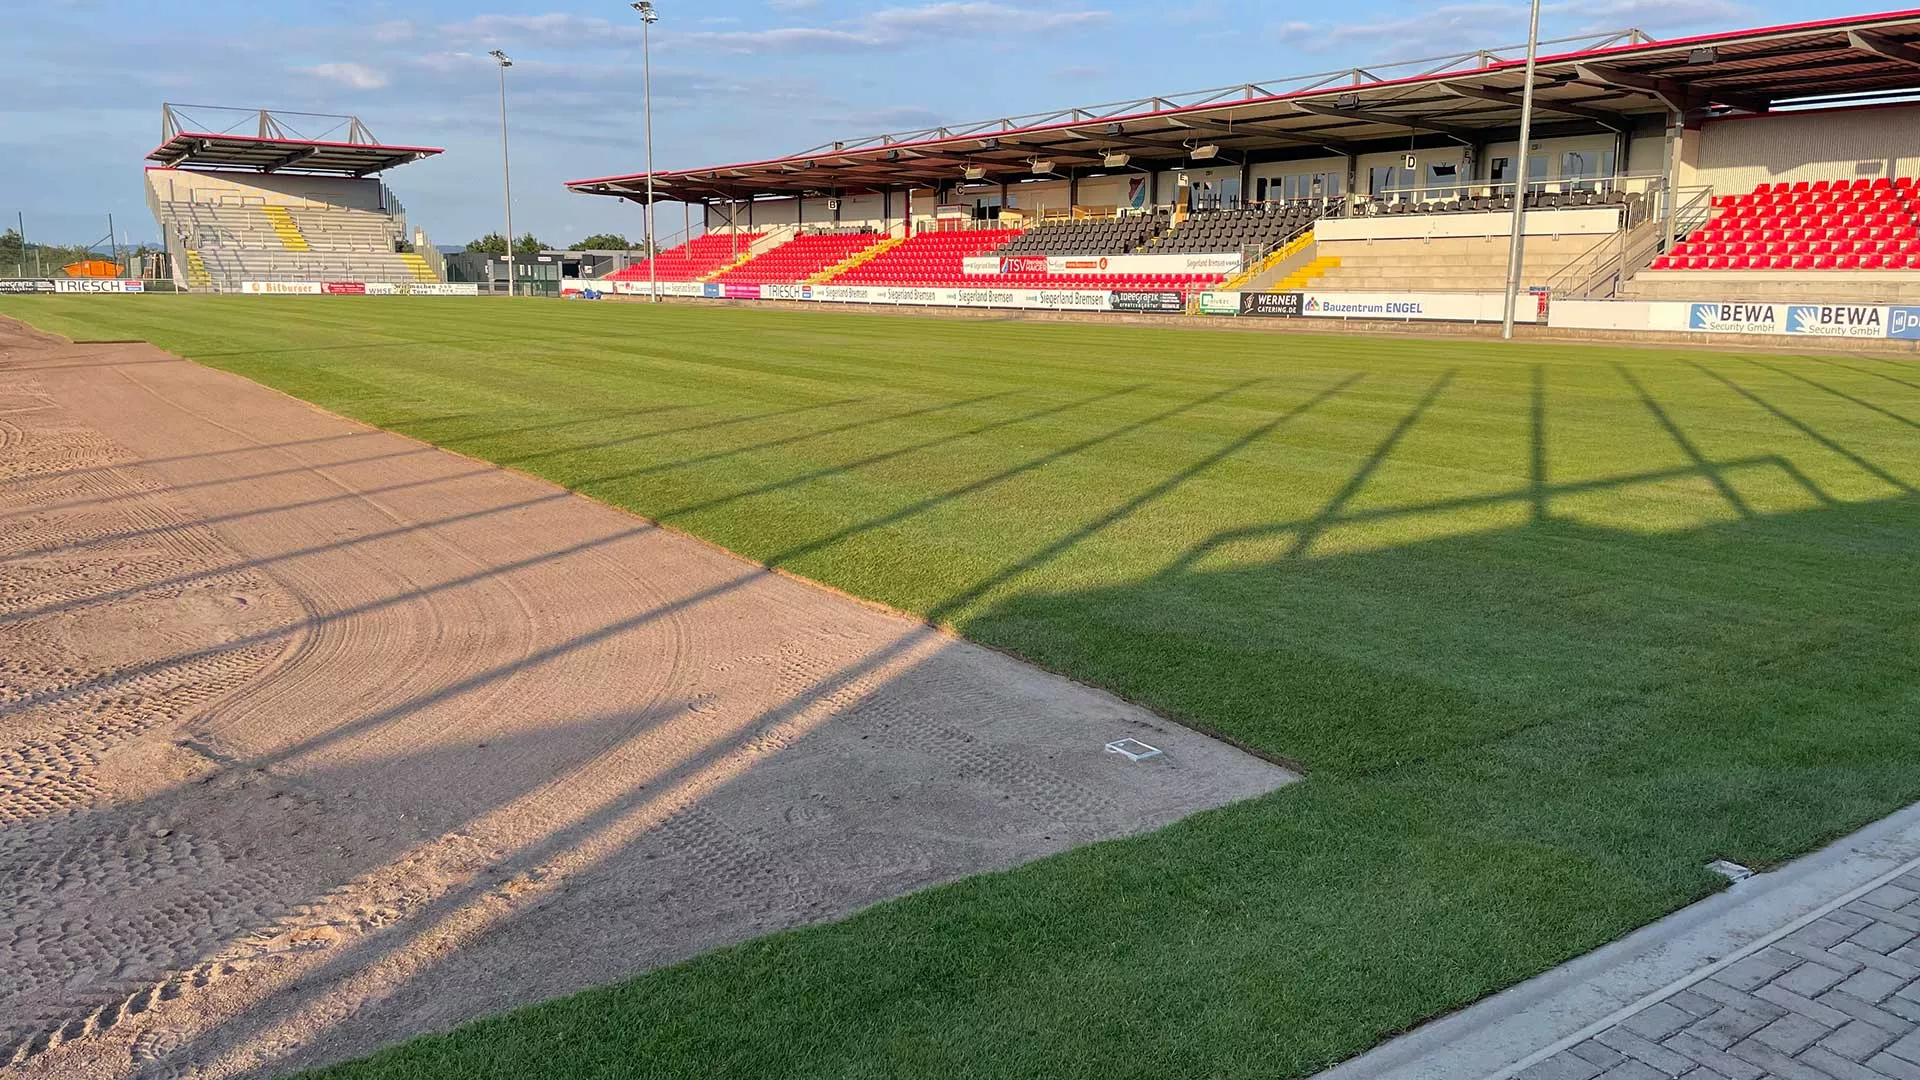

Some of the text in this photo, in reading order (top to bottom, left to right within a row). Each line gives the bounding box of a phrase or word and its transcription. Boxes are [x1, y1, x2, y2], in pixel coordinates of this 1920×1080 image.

[1008, 258, 1027, 272] TSV
[57, 280, 120, 292] TRIESCH
[266, 282, 313, 293] Bitburger
[768, 285, 800, 298] TRIESCH
[825, 287, 849, 300] Siegerland
[849, 288, 868, 299] Bremsen
[887, 288, 935, 302] Siegerland Bremsen
[958, 290, 1014, 304] Siegerland Bremsen
[1039, 291, 1104, 307] Siegerland Bremsen
[1258, 294, 1298, 306] WERNER
[1257, 306, 1297, 314] CATERING.DE
[1323, 301, 1423, 314] Bauzentrum ENGEL
[1720, 304, 1775, 323] BEWA
[1820, 307, 1881, 326] BEWA
[1710, 321, 1775, 332] Security GmbH
[1808, 325, 1880, 336] Security GmbH
